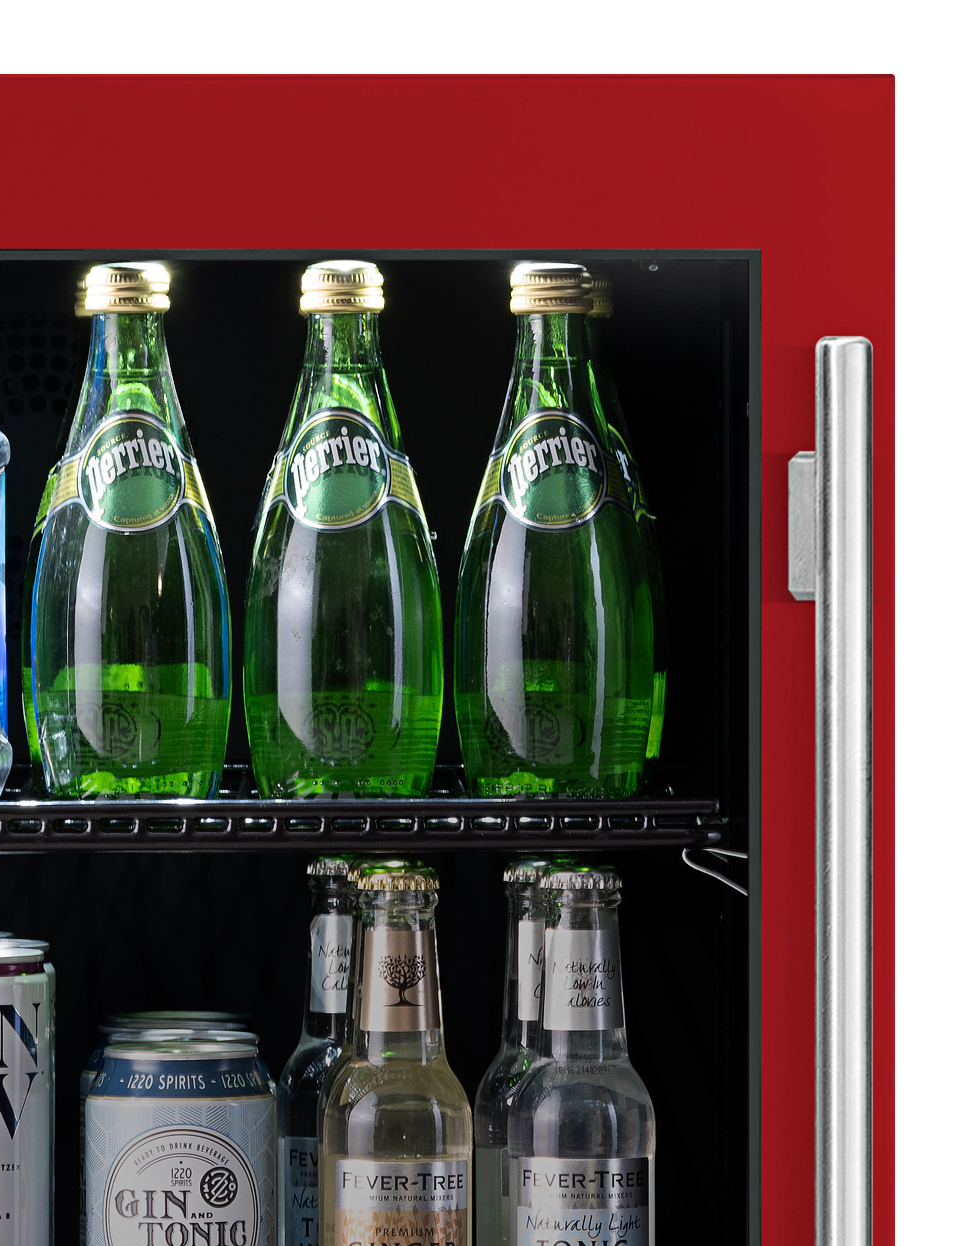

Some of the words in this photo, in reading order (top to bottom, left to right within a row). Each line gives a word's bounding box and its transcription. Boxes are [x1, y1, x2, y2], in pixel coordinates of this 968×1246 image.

[97, 433, 126, 456] SOURCE
[303, 431, 330, 453] SOURCE
[519, 431, 548, 453] SOURCE
[114, 514, 152, 524] Captured
[316, 510, 354, 522] Captured
[552, 959, 616, 979] Naturally
[127, 1074, 153, 1089] 1220
[158, 1075, 206, 1090] SPIRITS
[221, 1074, 246, 1089] 1220
[134, 1149, 153, 1166] READY
[156, 1145, 166, 1153] TO
[169, 1143, 193, 1151] DRINK
[196, 1144, 230, 1166] BEVERAGE
[171, 1168, 192, 1179] 1220
[342, 1172, 464, 1191] FEVER-TREE
[523, 1170, 643, 1189] FEVER-TREE
[115, 1189, 191, 1219] GIN
[376, 1228, 434, 1237] PREMIUM
[526, 1209, 602, 1238] Naturally
[609, 1215, 641, 1238] Light
